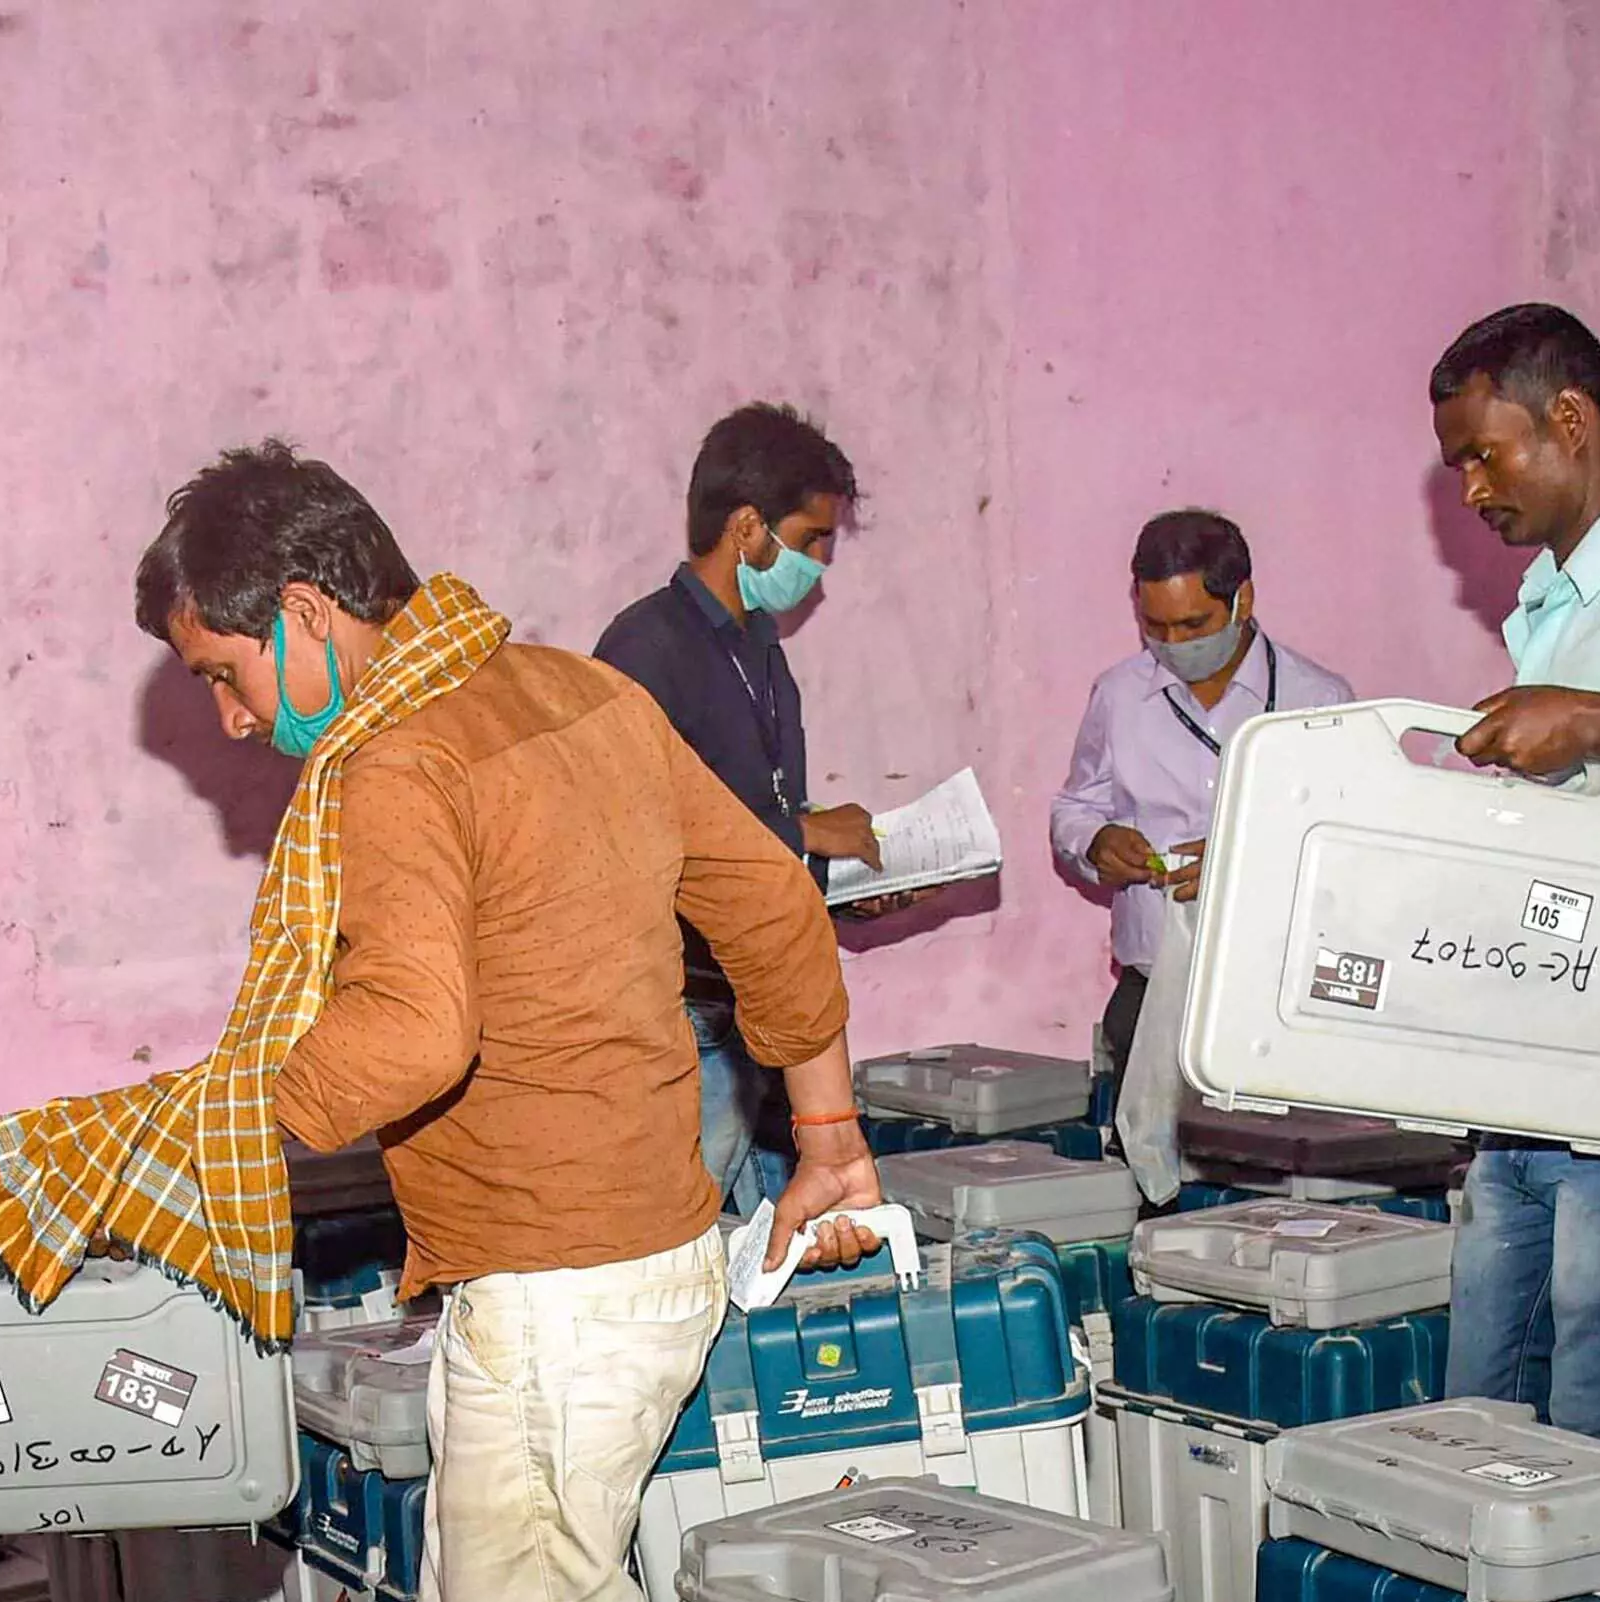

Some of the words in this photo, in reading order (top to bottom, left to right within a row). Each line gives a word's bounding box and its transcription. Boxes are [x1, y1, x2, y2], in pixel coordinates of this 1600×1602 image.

[1531, 904, 1561, 929] 105
[1338, 957, 1378, 986] 183
[105, 1374, 158, 1409] 183
